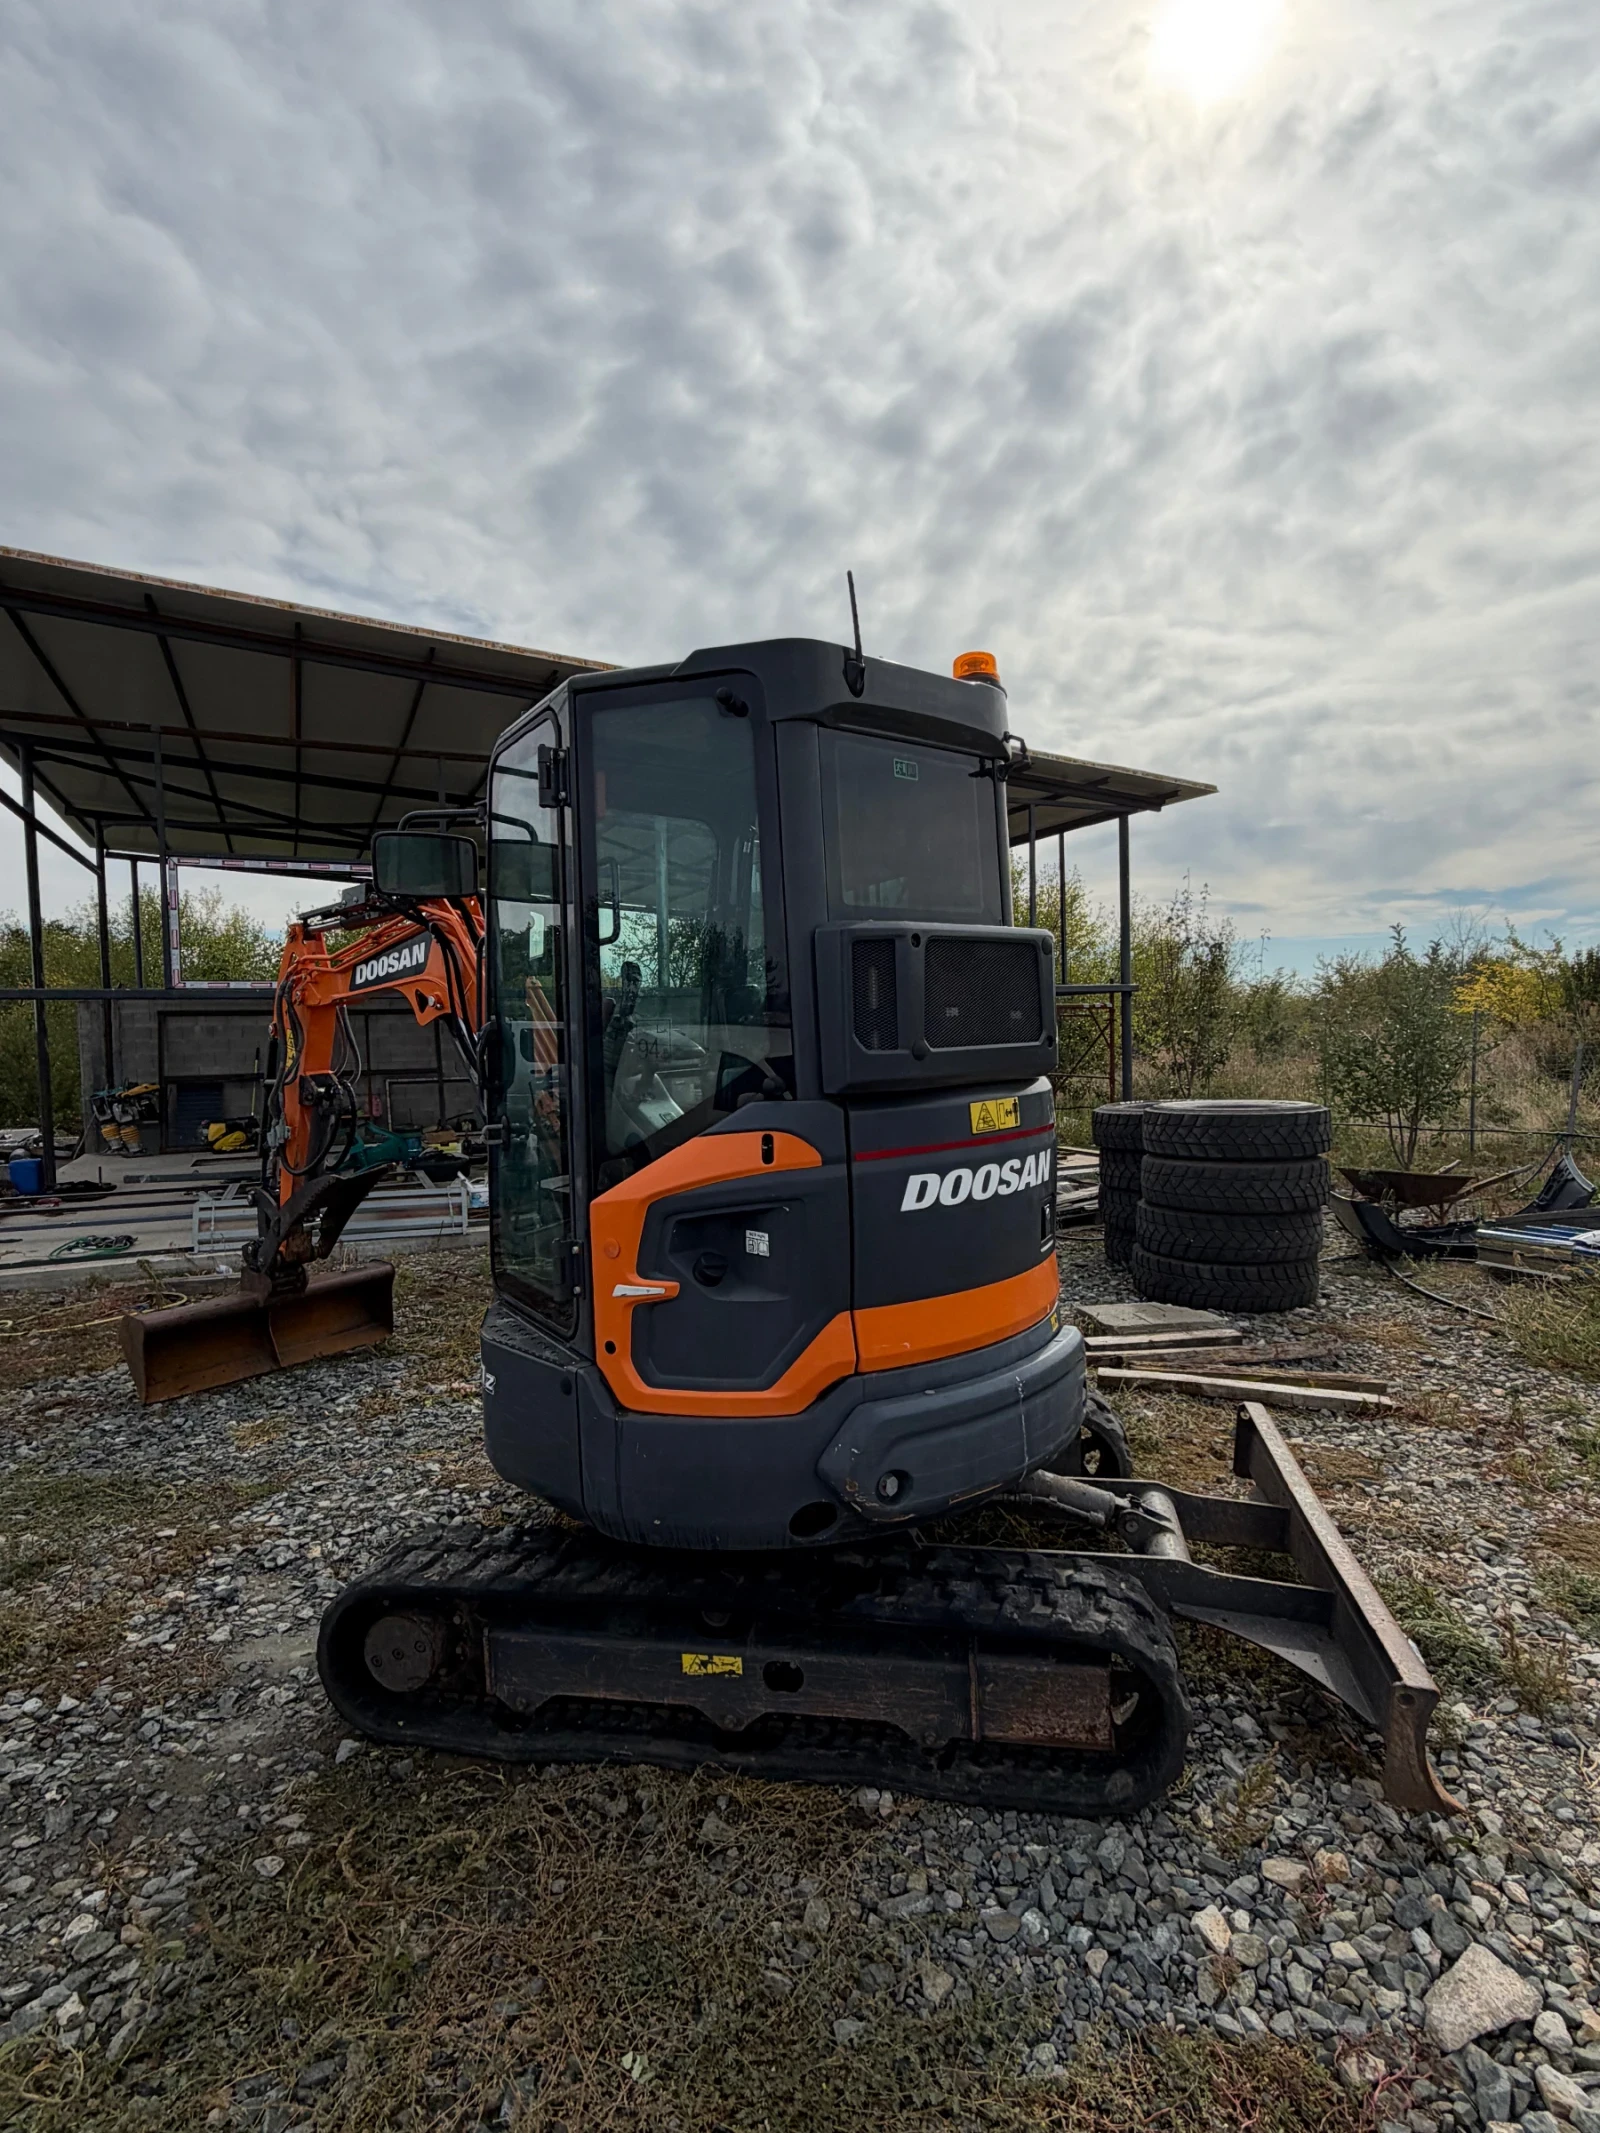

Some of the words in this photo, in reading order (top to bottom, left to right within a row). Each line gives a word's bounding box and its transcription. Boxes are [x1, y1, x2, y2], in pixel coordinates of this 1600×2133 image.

[355, 942, 426, 985] DOOSAN
[638, 1037, 660, 1059] 94
[900, 1148, 1051, 1212] DOOSAN
